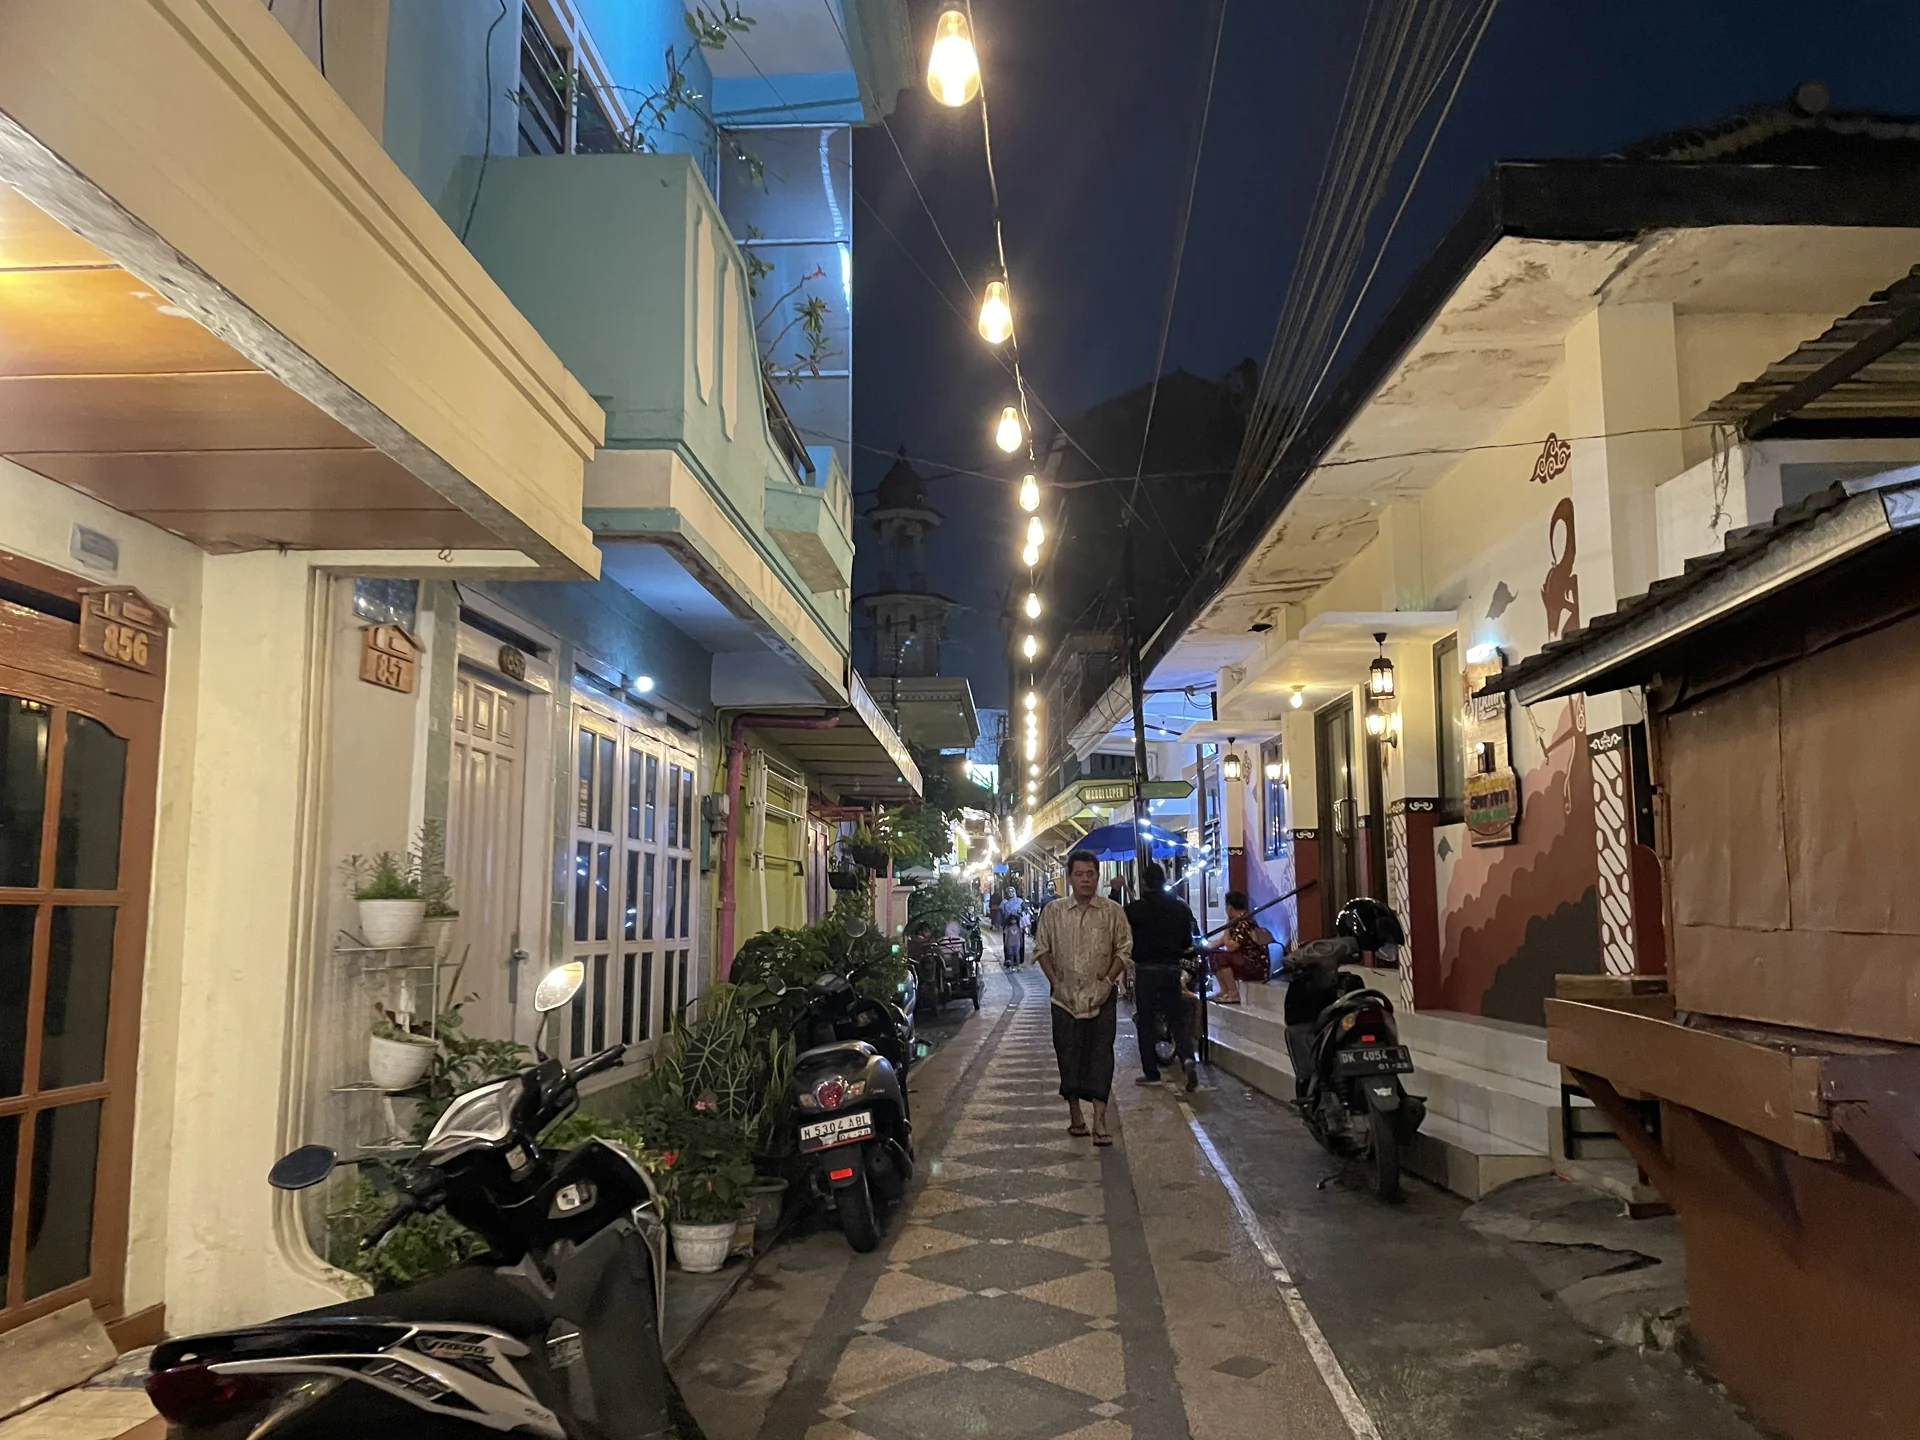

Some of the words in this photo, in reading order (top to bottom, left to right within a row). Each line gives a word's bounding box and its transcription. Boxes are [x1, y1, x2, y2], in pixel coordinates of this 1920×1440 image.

[103, 623, 149, 666] 856
[376, 653, 402, 688] 857
[1341, 1052, 1356, 1064] DK
[1362, 1049, 1388, 1061] 4054
[804, 1129, 811, 1140] N
[814, 1120, 844, 1136] 5304
[848, 1115, 869, 1128] ABL
